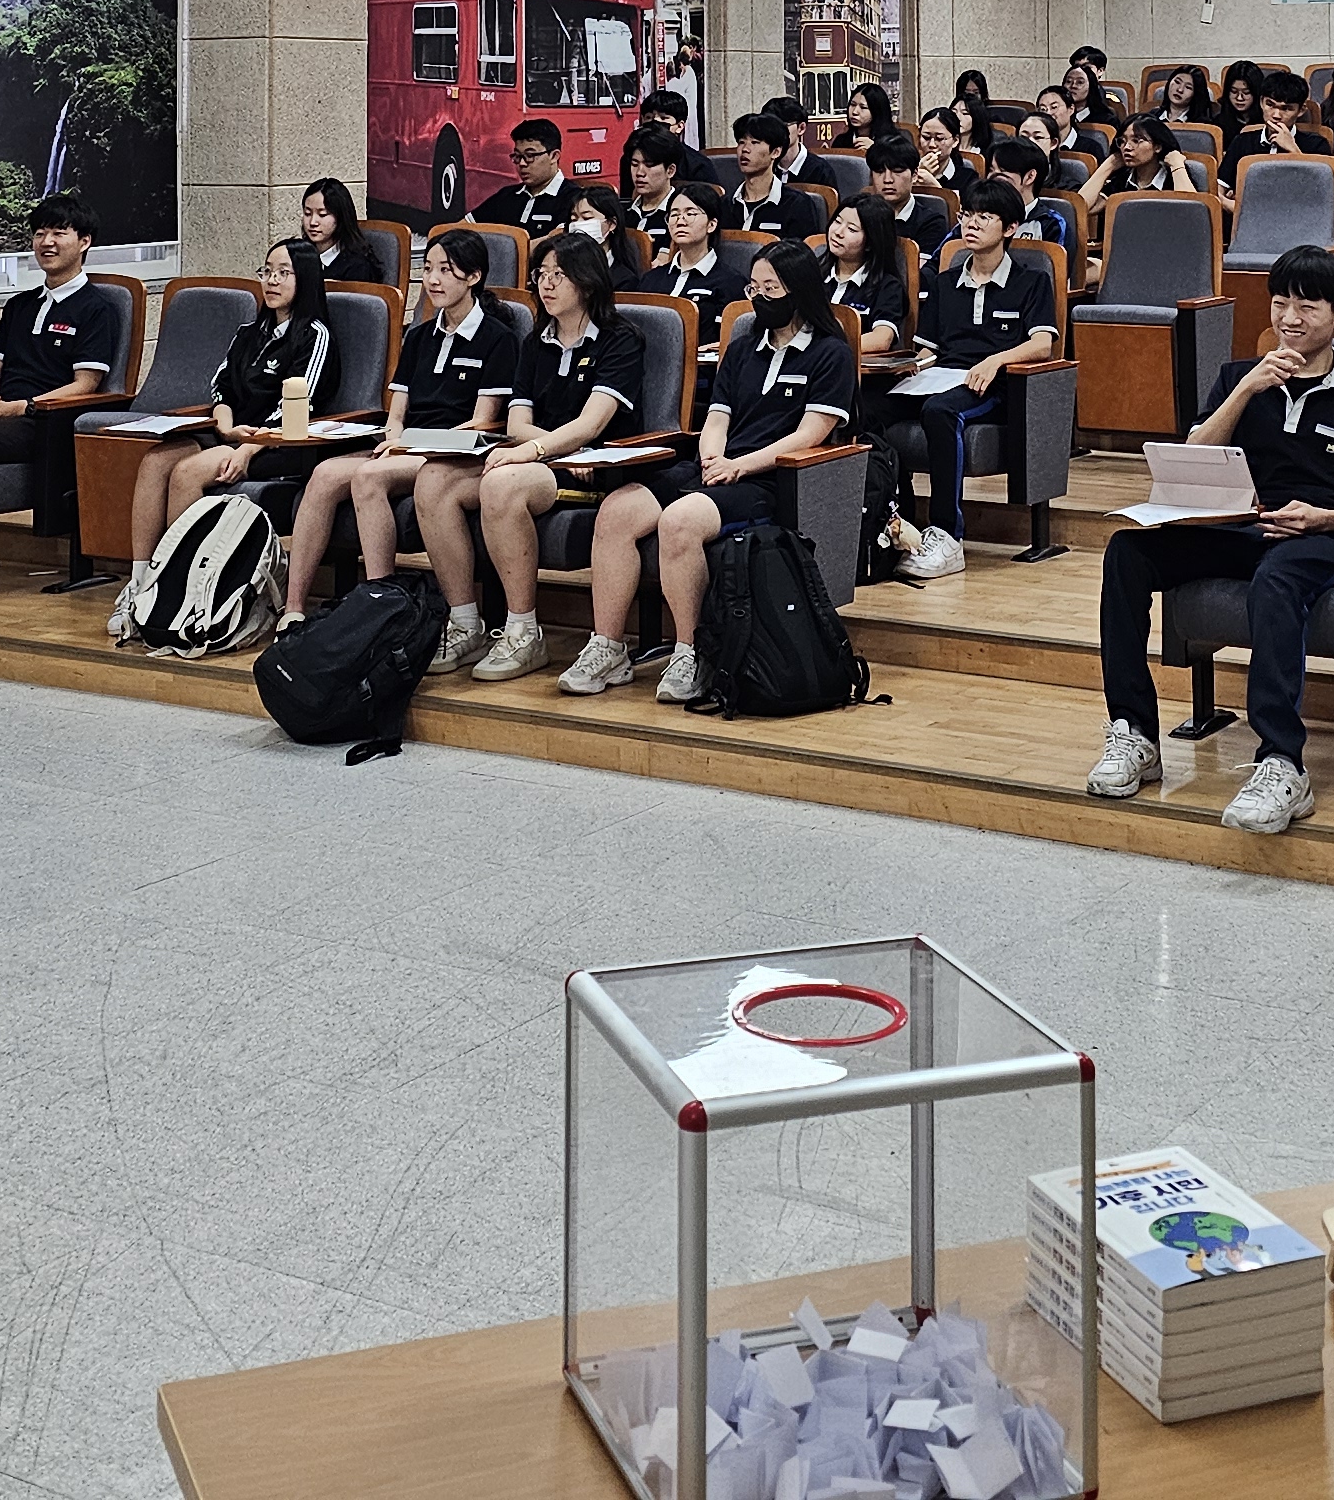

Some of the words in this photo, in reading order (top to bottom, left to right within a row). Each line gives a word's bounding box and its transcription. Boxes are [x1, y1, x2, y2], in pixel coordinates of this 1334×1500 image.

[1095, 1189, 1148, 1210] 기후
[1151, 1177, 1209, 1197] 시민
[1129, 1195, 1197, 1214] 입니다
